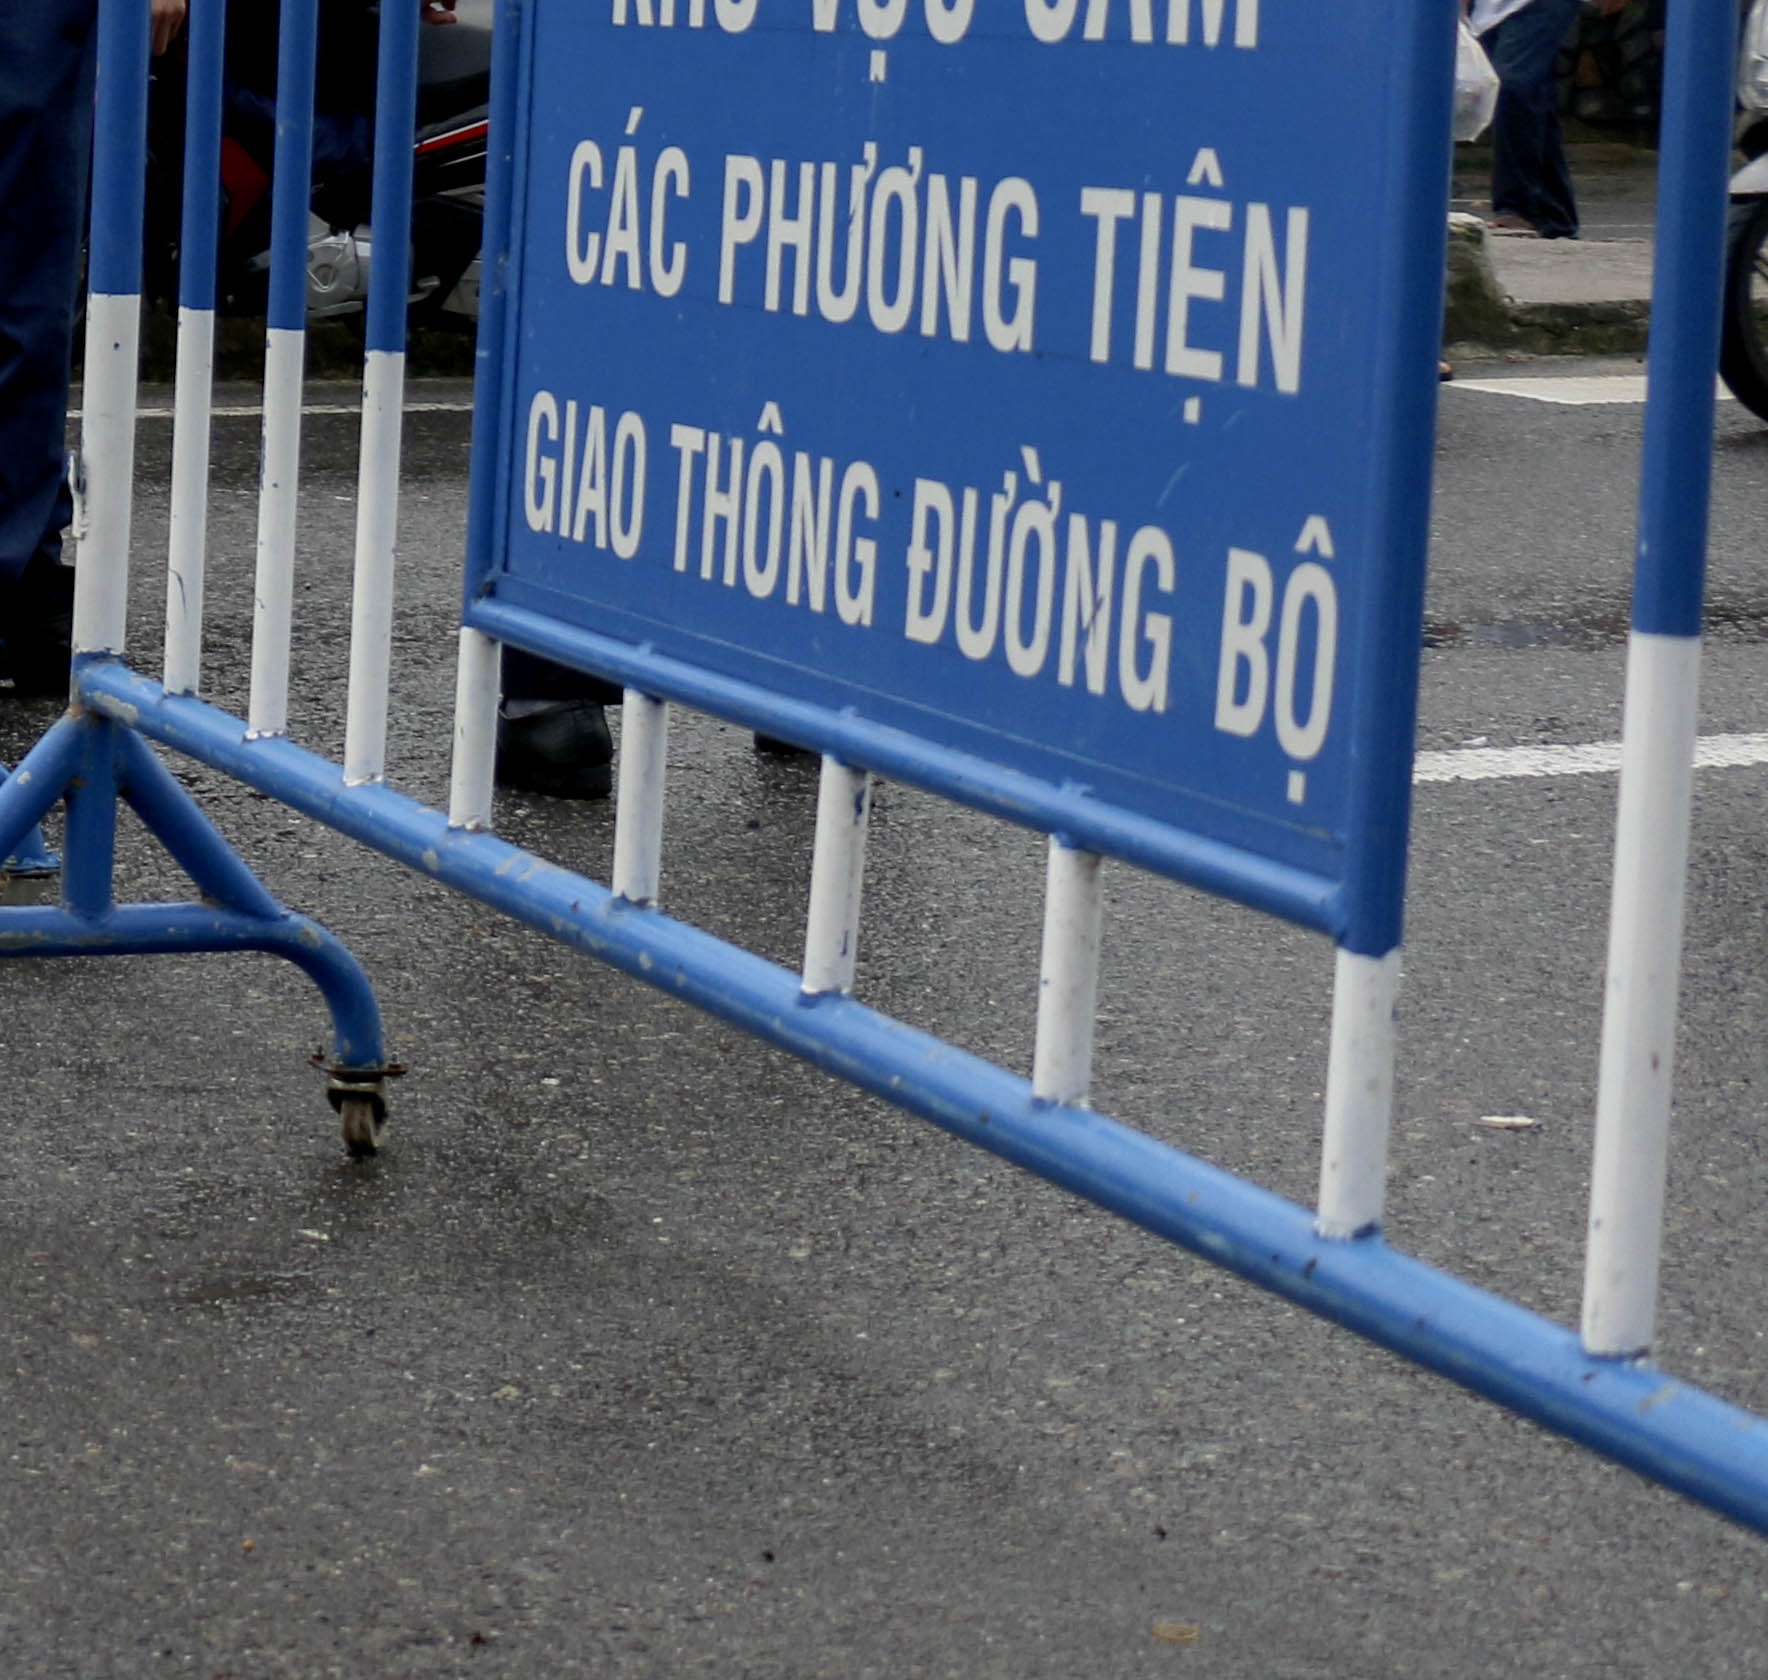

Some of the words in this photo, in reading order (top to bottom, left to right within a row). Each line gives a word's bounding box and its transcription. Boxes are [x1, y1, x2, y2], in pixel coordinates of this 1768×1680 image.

[565, 106, 688, 299] CÁC
[716, 143, 1040, 355] PHƯƠNG
[1079, 149, 1310, 425] TIỆN
[525, 390, 648, 561] GIAO
[669, 402, 881, 629] THÔNG
[902, 444, 1176, 715] ĐƯỜNG
[1214, 516, 1340, 805] BỘ
